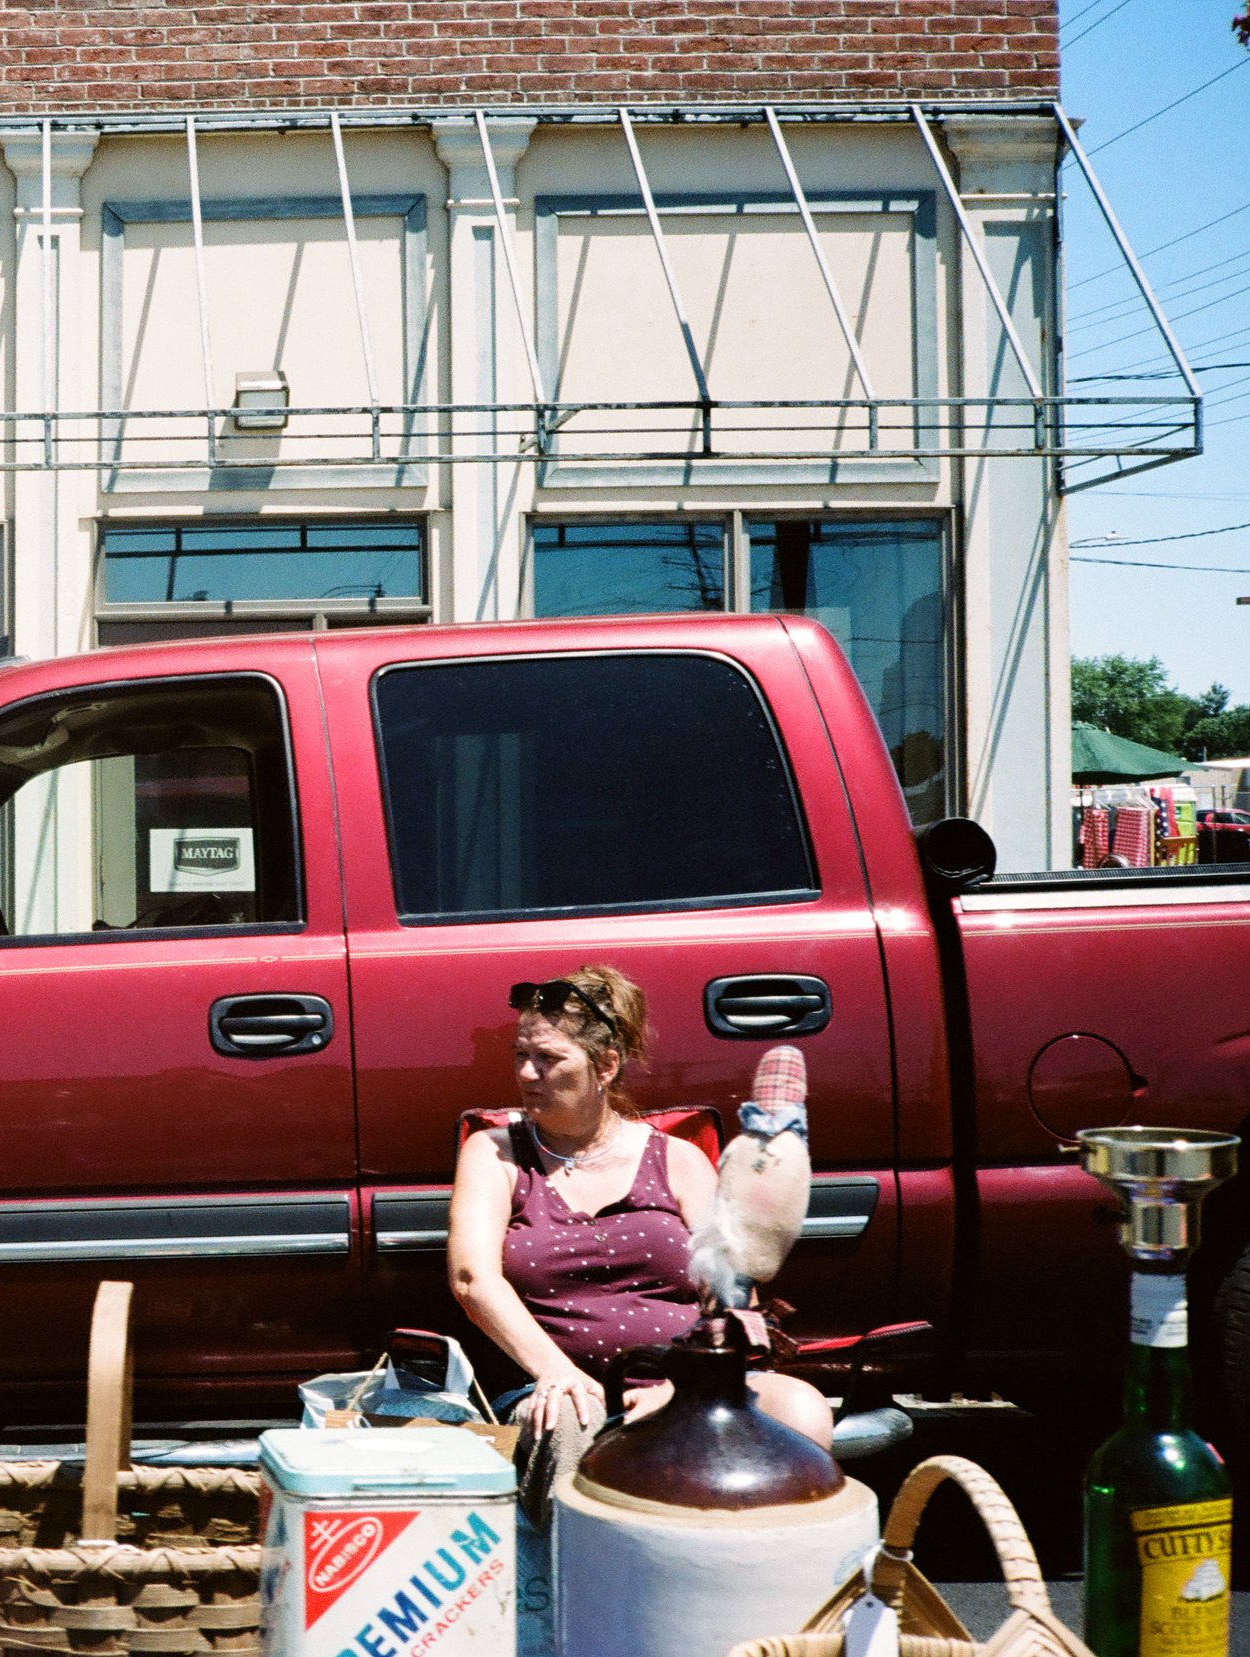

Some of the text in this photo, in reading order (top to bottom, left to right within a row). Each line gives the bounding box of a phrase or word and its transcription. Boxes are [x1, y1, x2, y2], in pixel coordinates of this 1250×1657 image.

[181, 847, 234, 859] MAYTAG
[314, 1523, 377, 1587] NABISCO
[336, 1511, 502, 1657] EMIUM
[409, 1558, 505, 1657] CRACKERS
